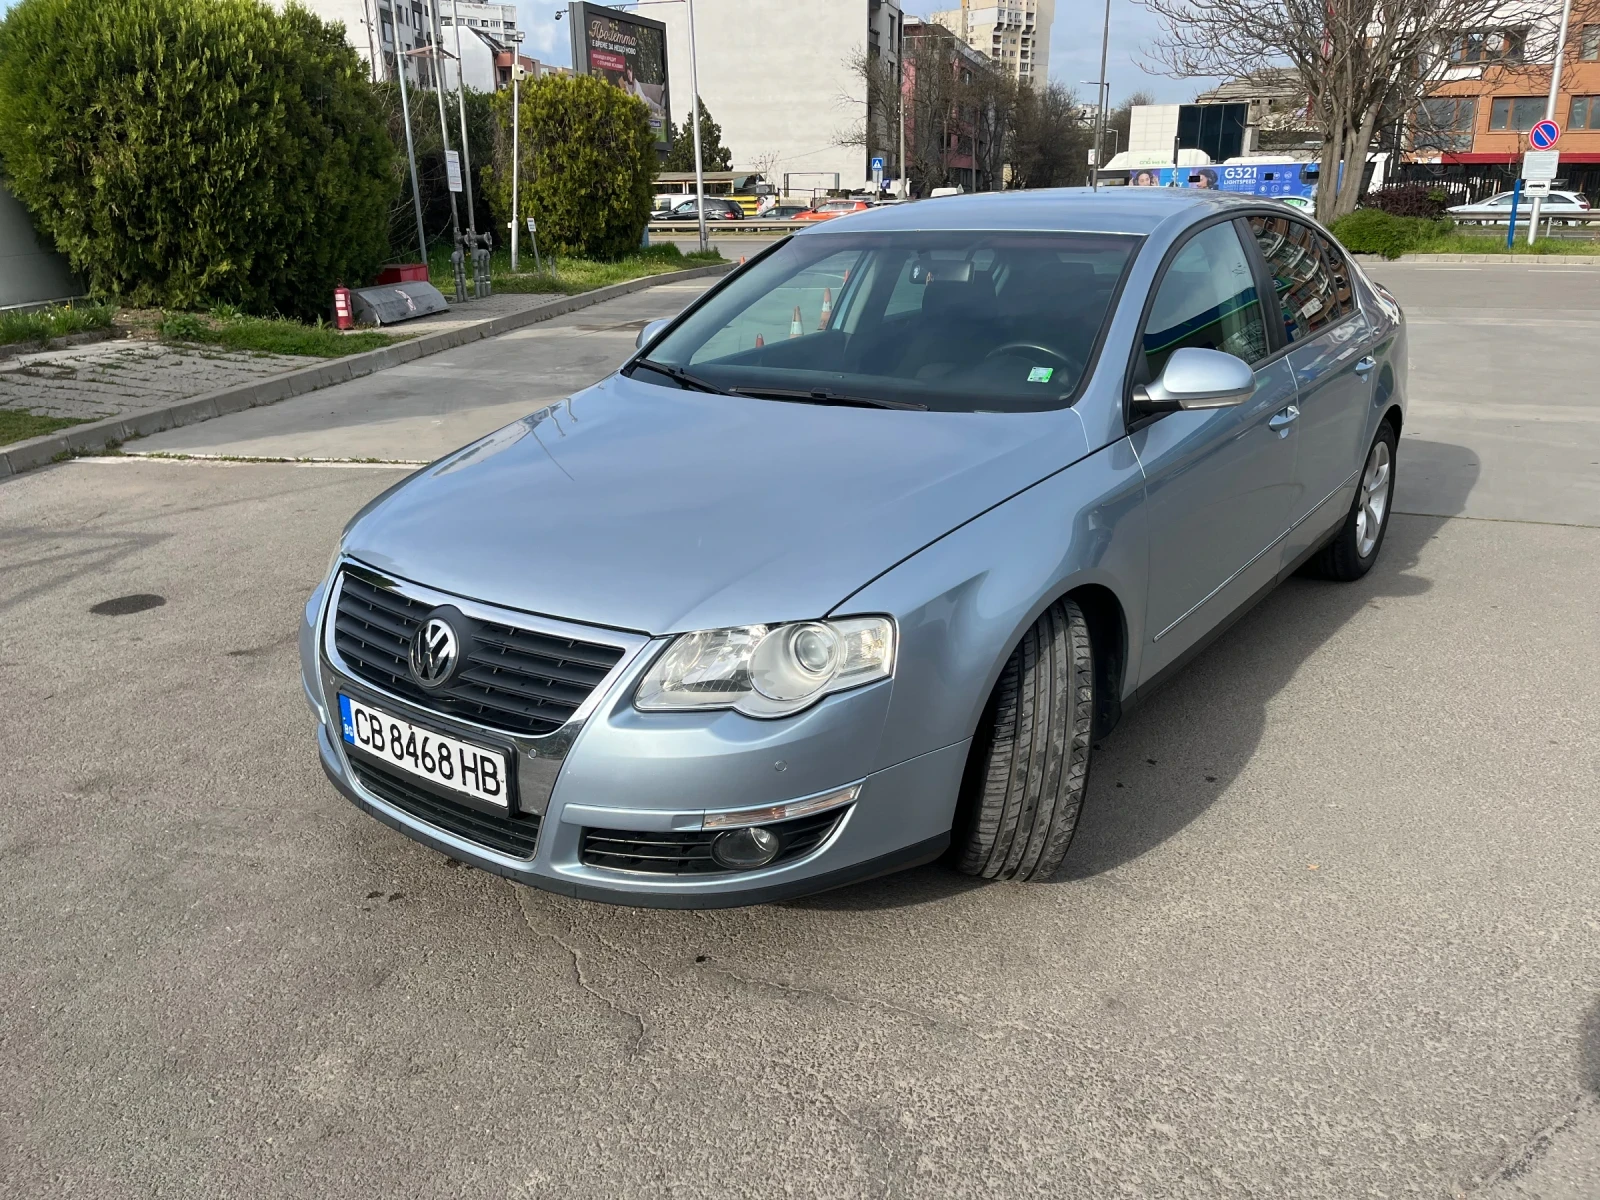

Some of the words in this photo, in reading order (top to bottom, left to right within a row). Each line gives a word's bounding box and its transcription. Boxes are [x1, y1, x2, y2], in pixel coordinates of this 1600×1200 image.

[591, 20, 637, 46] Пролетта
[626, 47, 637, 55] НОВО
[1224, 167, 1258, 179] G321
[343, 723, 354, 738] BG
[354, 708, 386, 752] CB
[390, 723, 454, 780] 8468
[459, 747, 501, 796] HB
